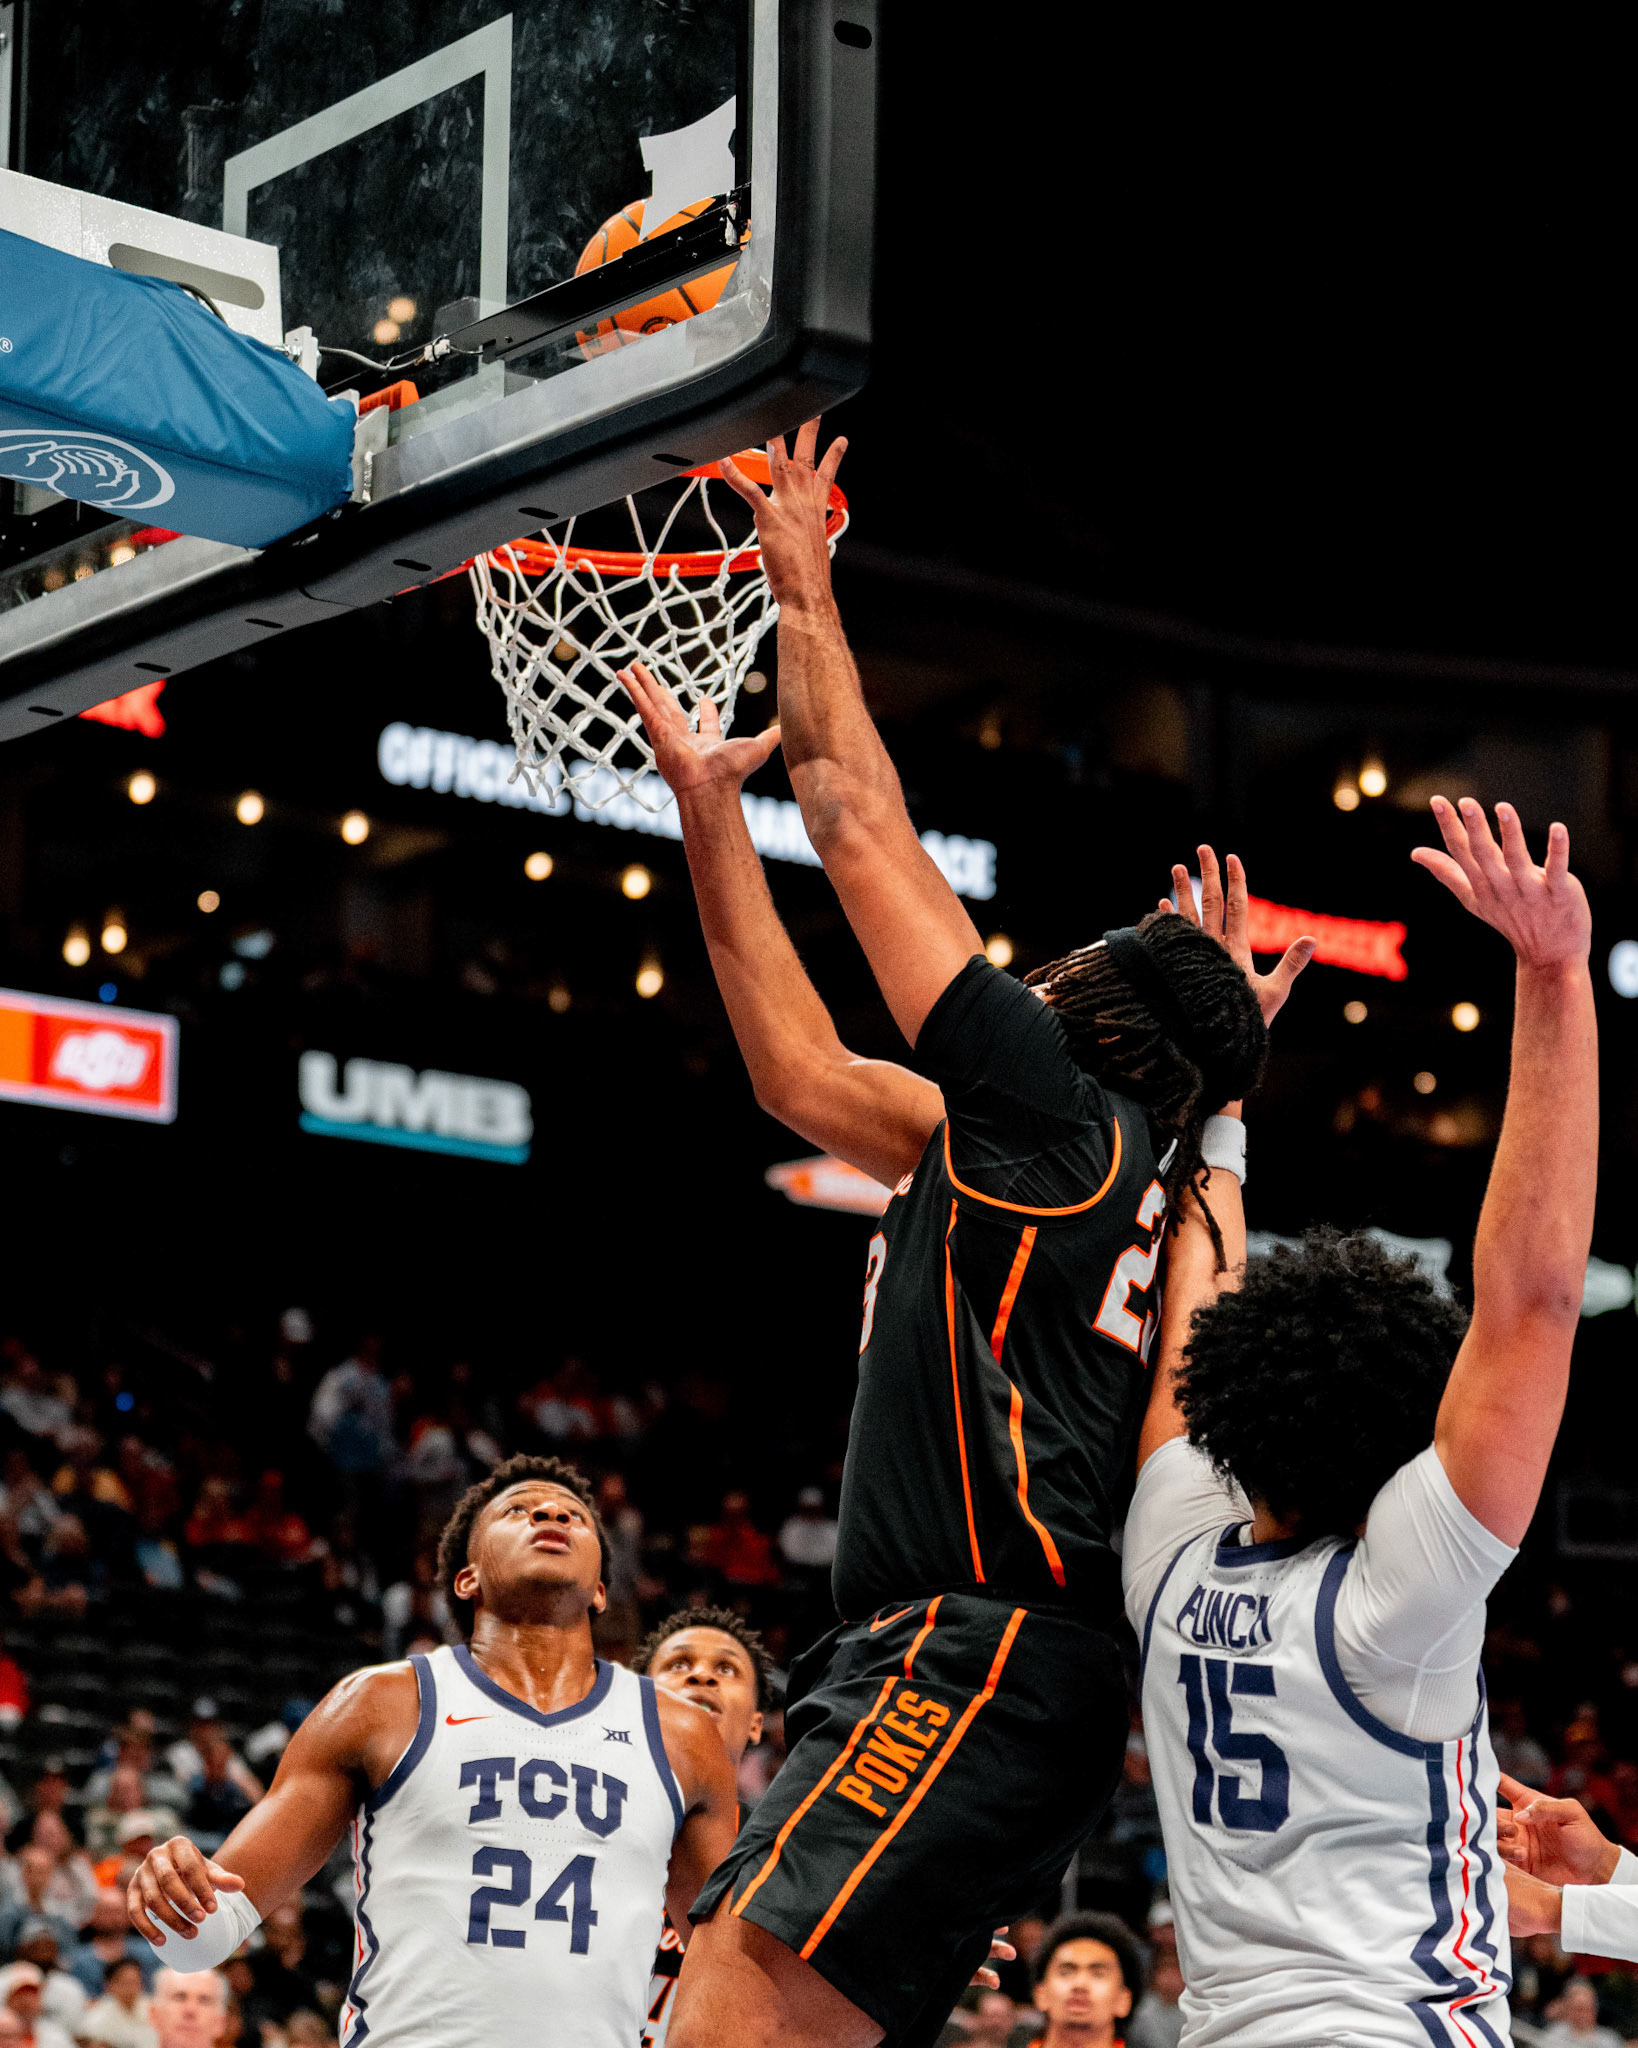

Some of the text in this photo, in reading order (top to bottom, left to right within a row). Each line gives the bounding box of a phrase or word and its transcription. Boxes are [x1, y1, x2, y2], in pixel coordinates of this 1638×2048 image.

[300, 1050, 534, 1147] UMB
[459, 1756, 629, 1839] TCU
[835, 1690, 951, 1818] POKES
[1177, 1653, 1291, 1832] 15
[467, 1845, 598, 1956] 24
